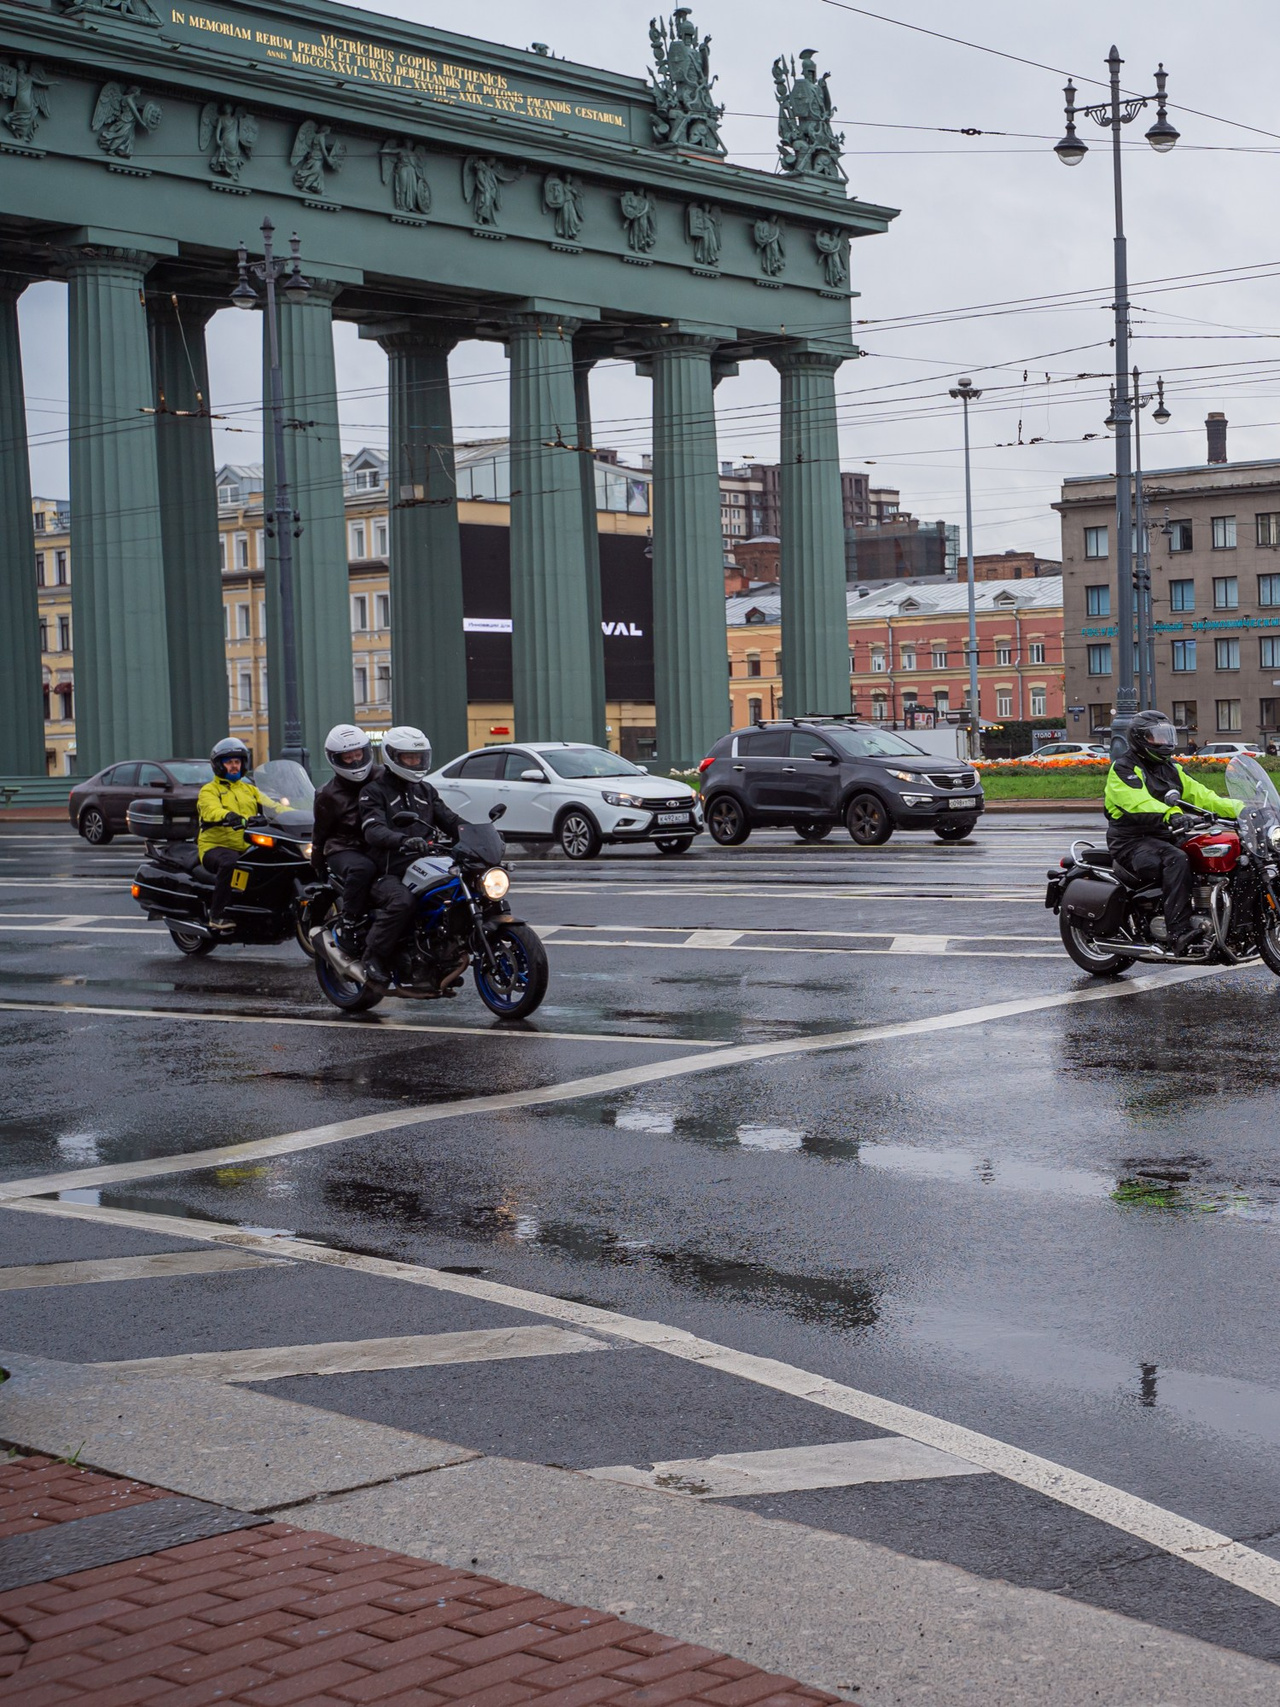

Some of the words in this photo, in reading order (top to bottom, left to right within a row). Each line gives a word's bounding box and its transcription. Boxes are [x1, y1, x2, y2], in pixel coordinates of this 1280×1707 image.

[171, 9, 185, 24] IN
[189, 15, 251, 41] MEMORIAM
[255, 31, 293, 51] RERUM
[298, 41, 334, 60] PERSIS
[338, 51, 351, 64] ET
[355, 55, 392, 73] TURCIS
[396, 65, 461, 90] DEBELLANDIS
[465, 81, 478, 93] AC
[483, 85, 524, 104] POLONIS
[526, 96, 571, 115] PACANDIS
[321, 34, 394, 63] VICTRICIBUS
[399, 53, 437, 73] COPIIS
[442, 63, 507, 90] RUTHENICIS
